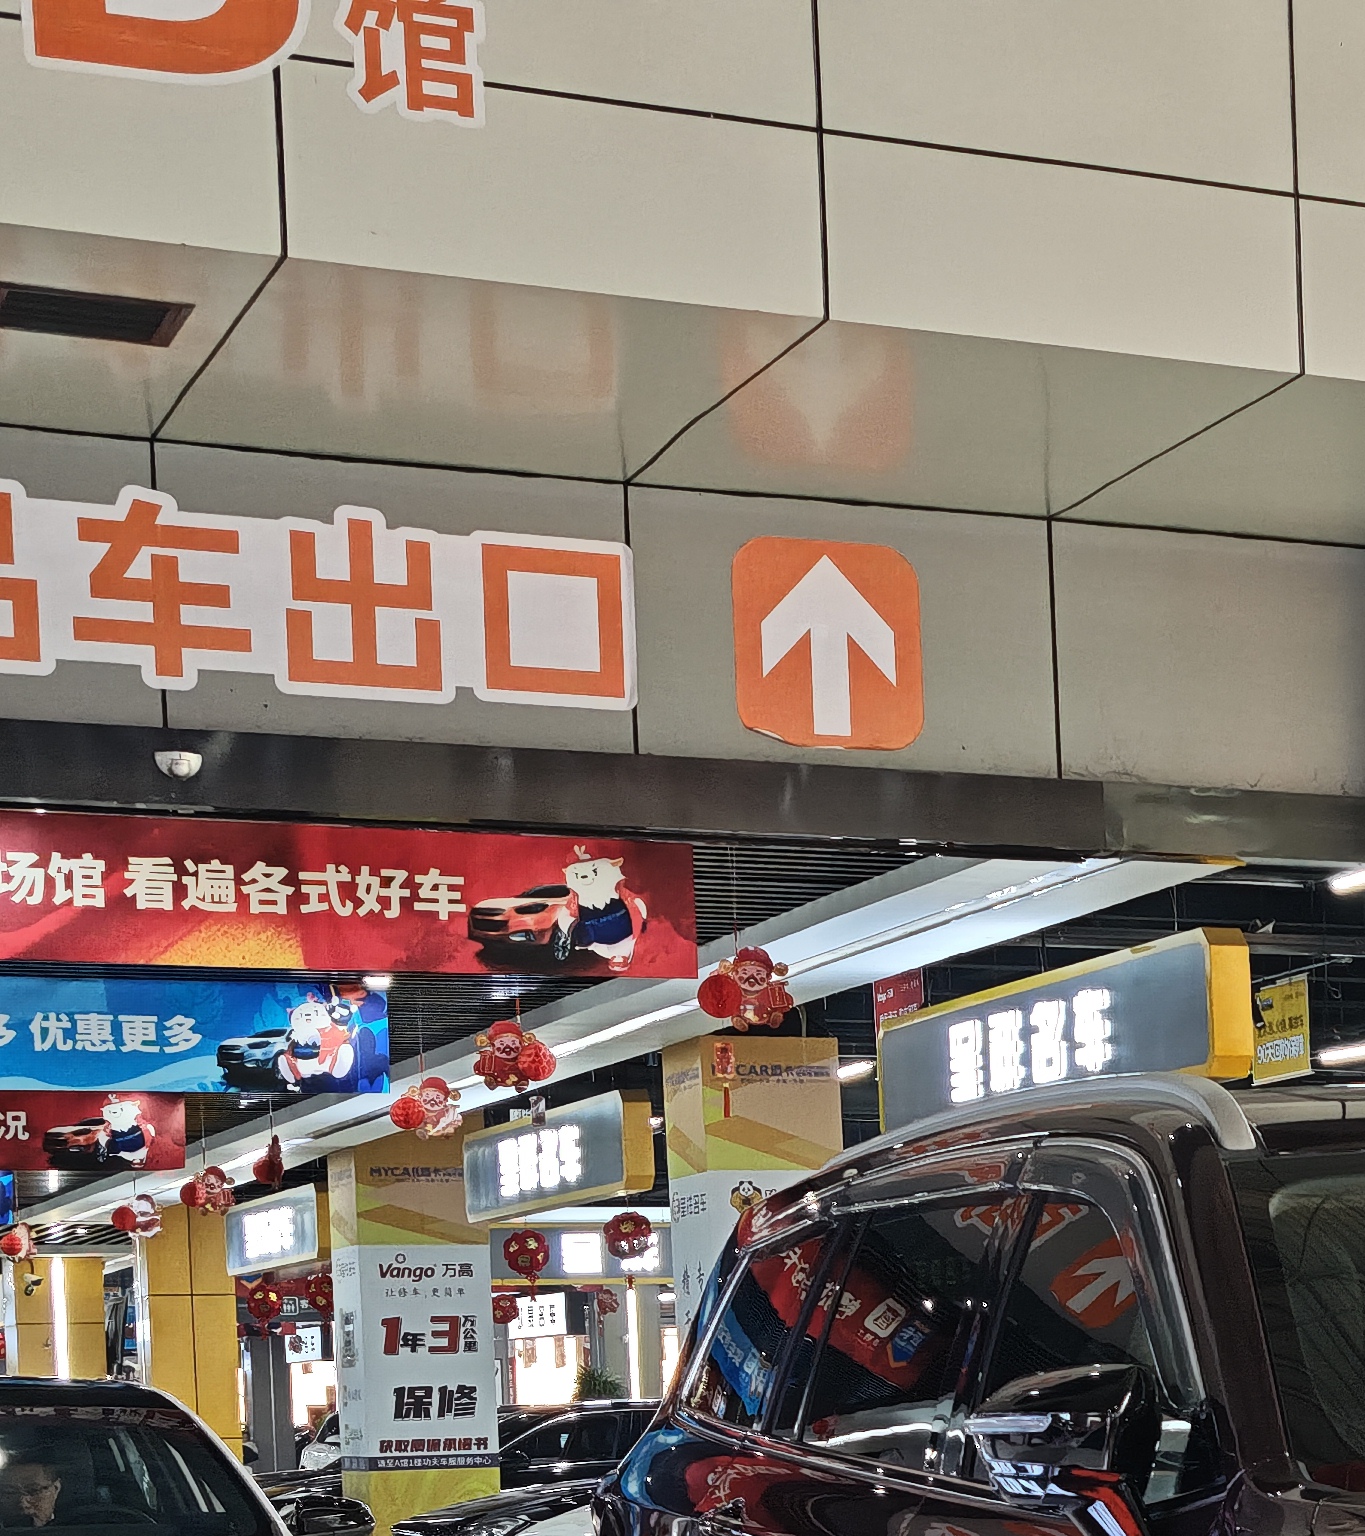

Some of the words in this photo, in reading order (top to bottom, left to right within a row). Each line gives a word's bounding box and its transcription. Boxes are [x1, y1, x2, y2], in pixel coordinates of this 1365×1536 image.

[123, 856, 466, 921] 看遍各式好车
[28, 1012, 203, 1053] 优惠更多
[378, 1263, 436, 1282] Vango
[441, 1263, 474, 1278] 万高
[393, 1384, 478, 1421] 保修
